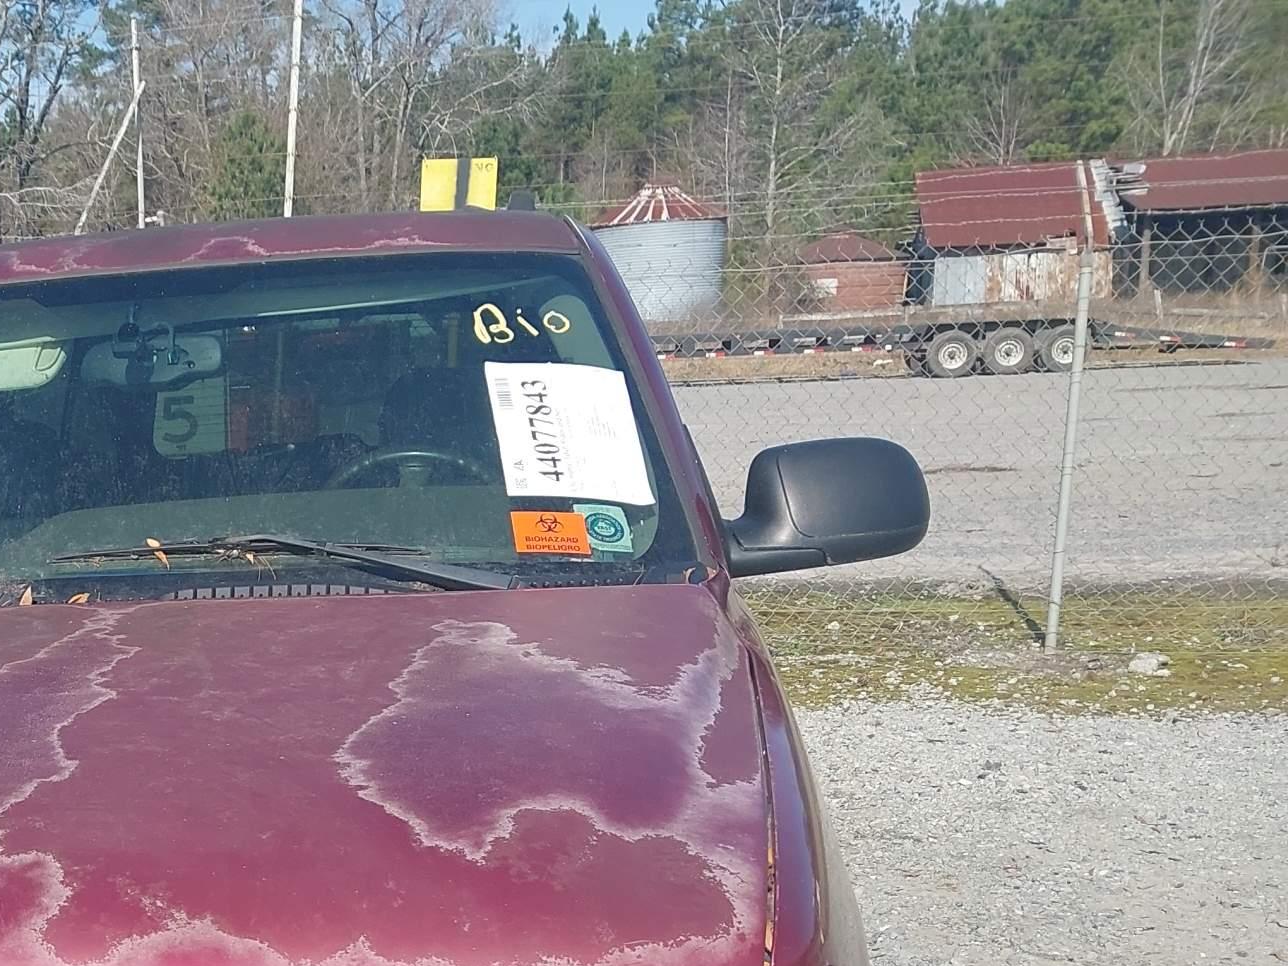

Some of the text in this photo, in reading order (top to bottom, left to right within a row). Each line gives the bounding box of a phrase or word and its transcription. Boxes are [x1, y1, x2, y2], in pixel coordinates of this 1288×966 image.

[473, 302, 571, 345] Bio
[521, 379, 565, 483] 44077843
[525, 535, 579, 543] BIOHAZARD
[526, 544, 581, 552] BIOPELIGRO
